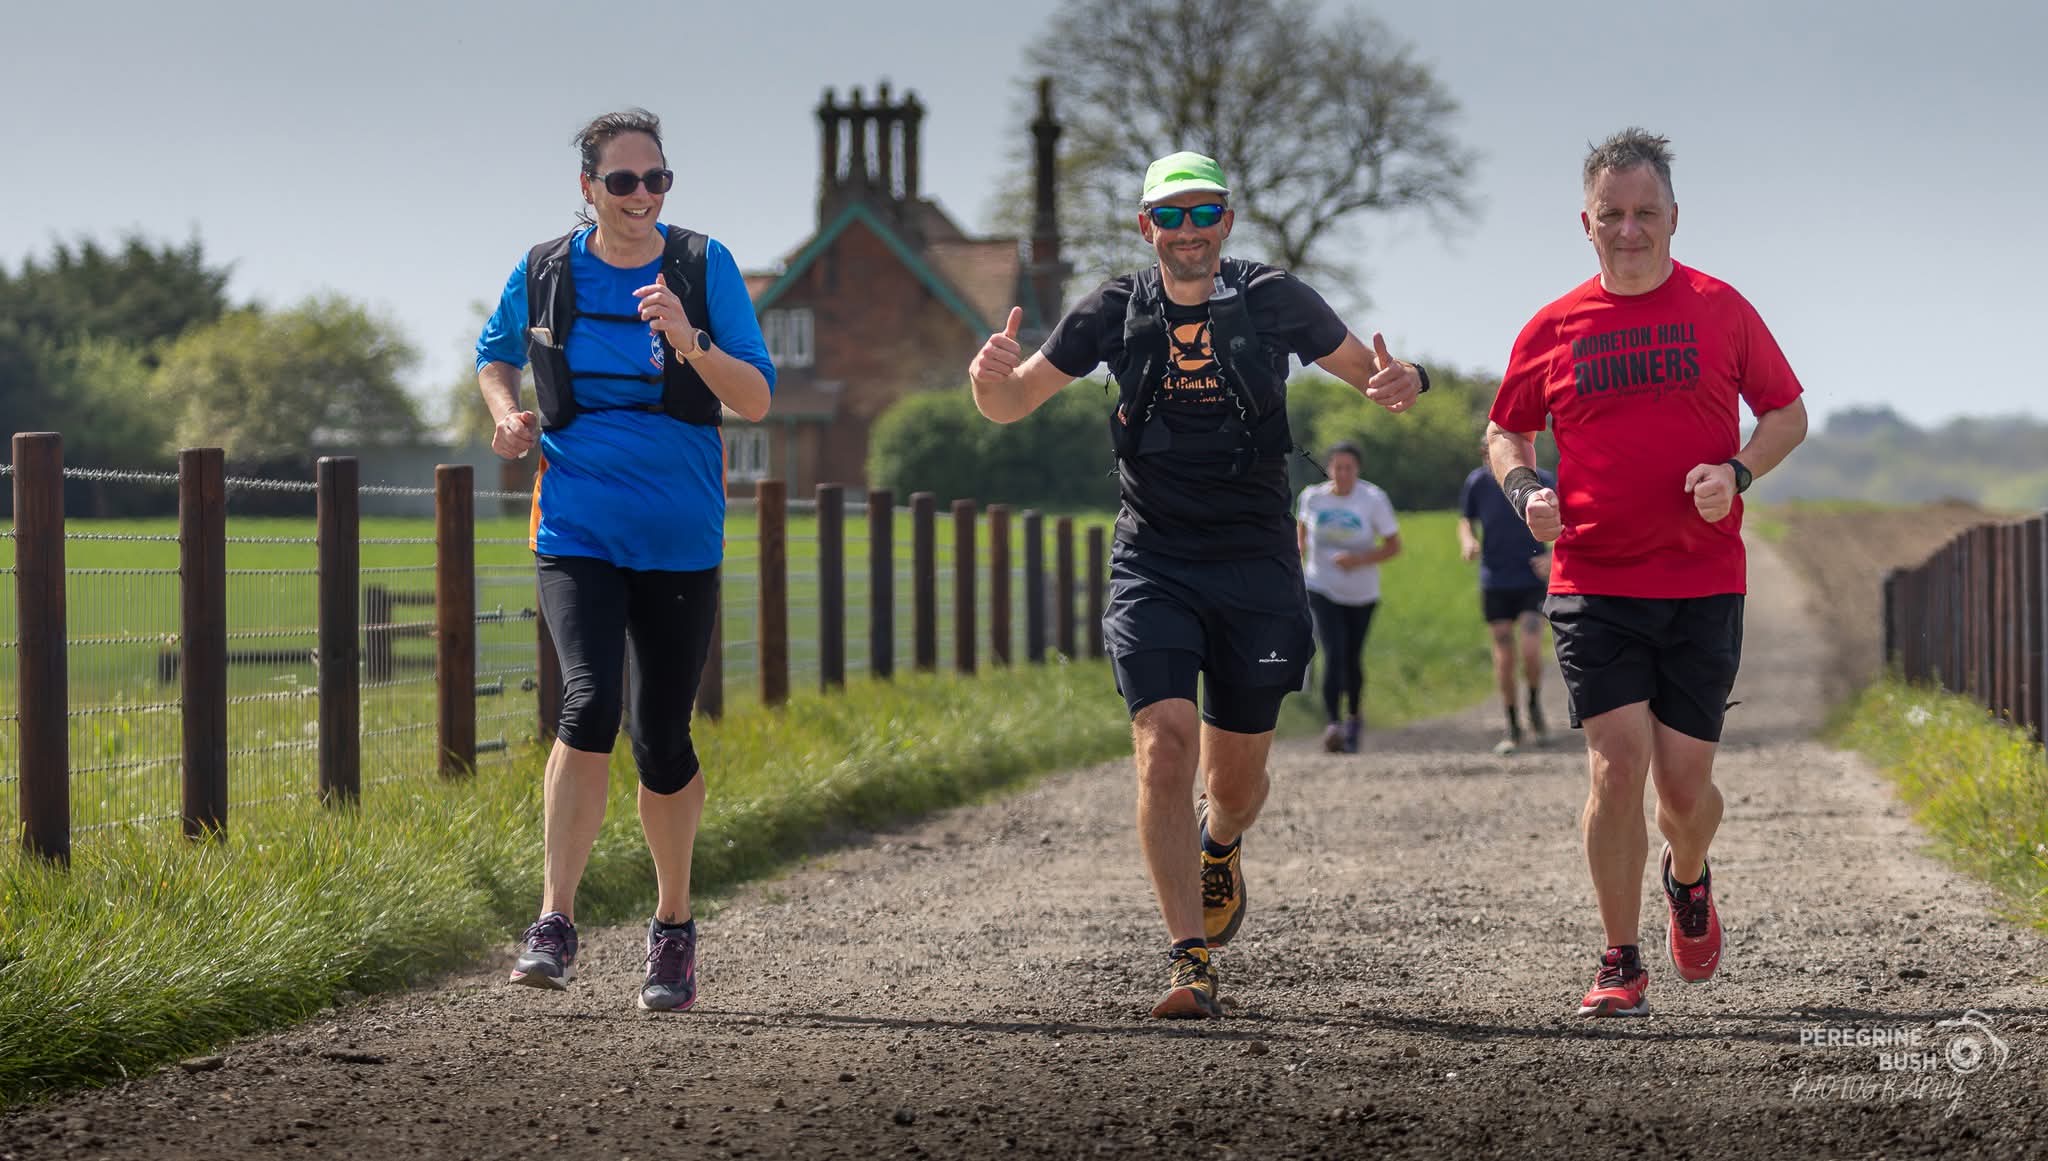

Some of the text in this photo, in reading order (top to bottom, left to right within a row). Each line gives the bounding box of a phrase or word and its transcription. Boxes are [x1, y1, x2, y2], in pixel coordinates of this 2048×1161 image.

[1572, 323, 1699, 359] MORETON HALL
[1574, 347, 1700, 396] RUNNERS
